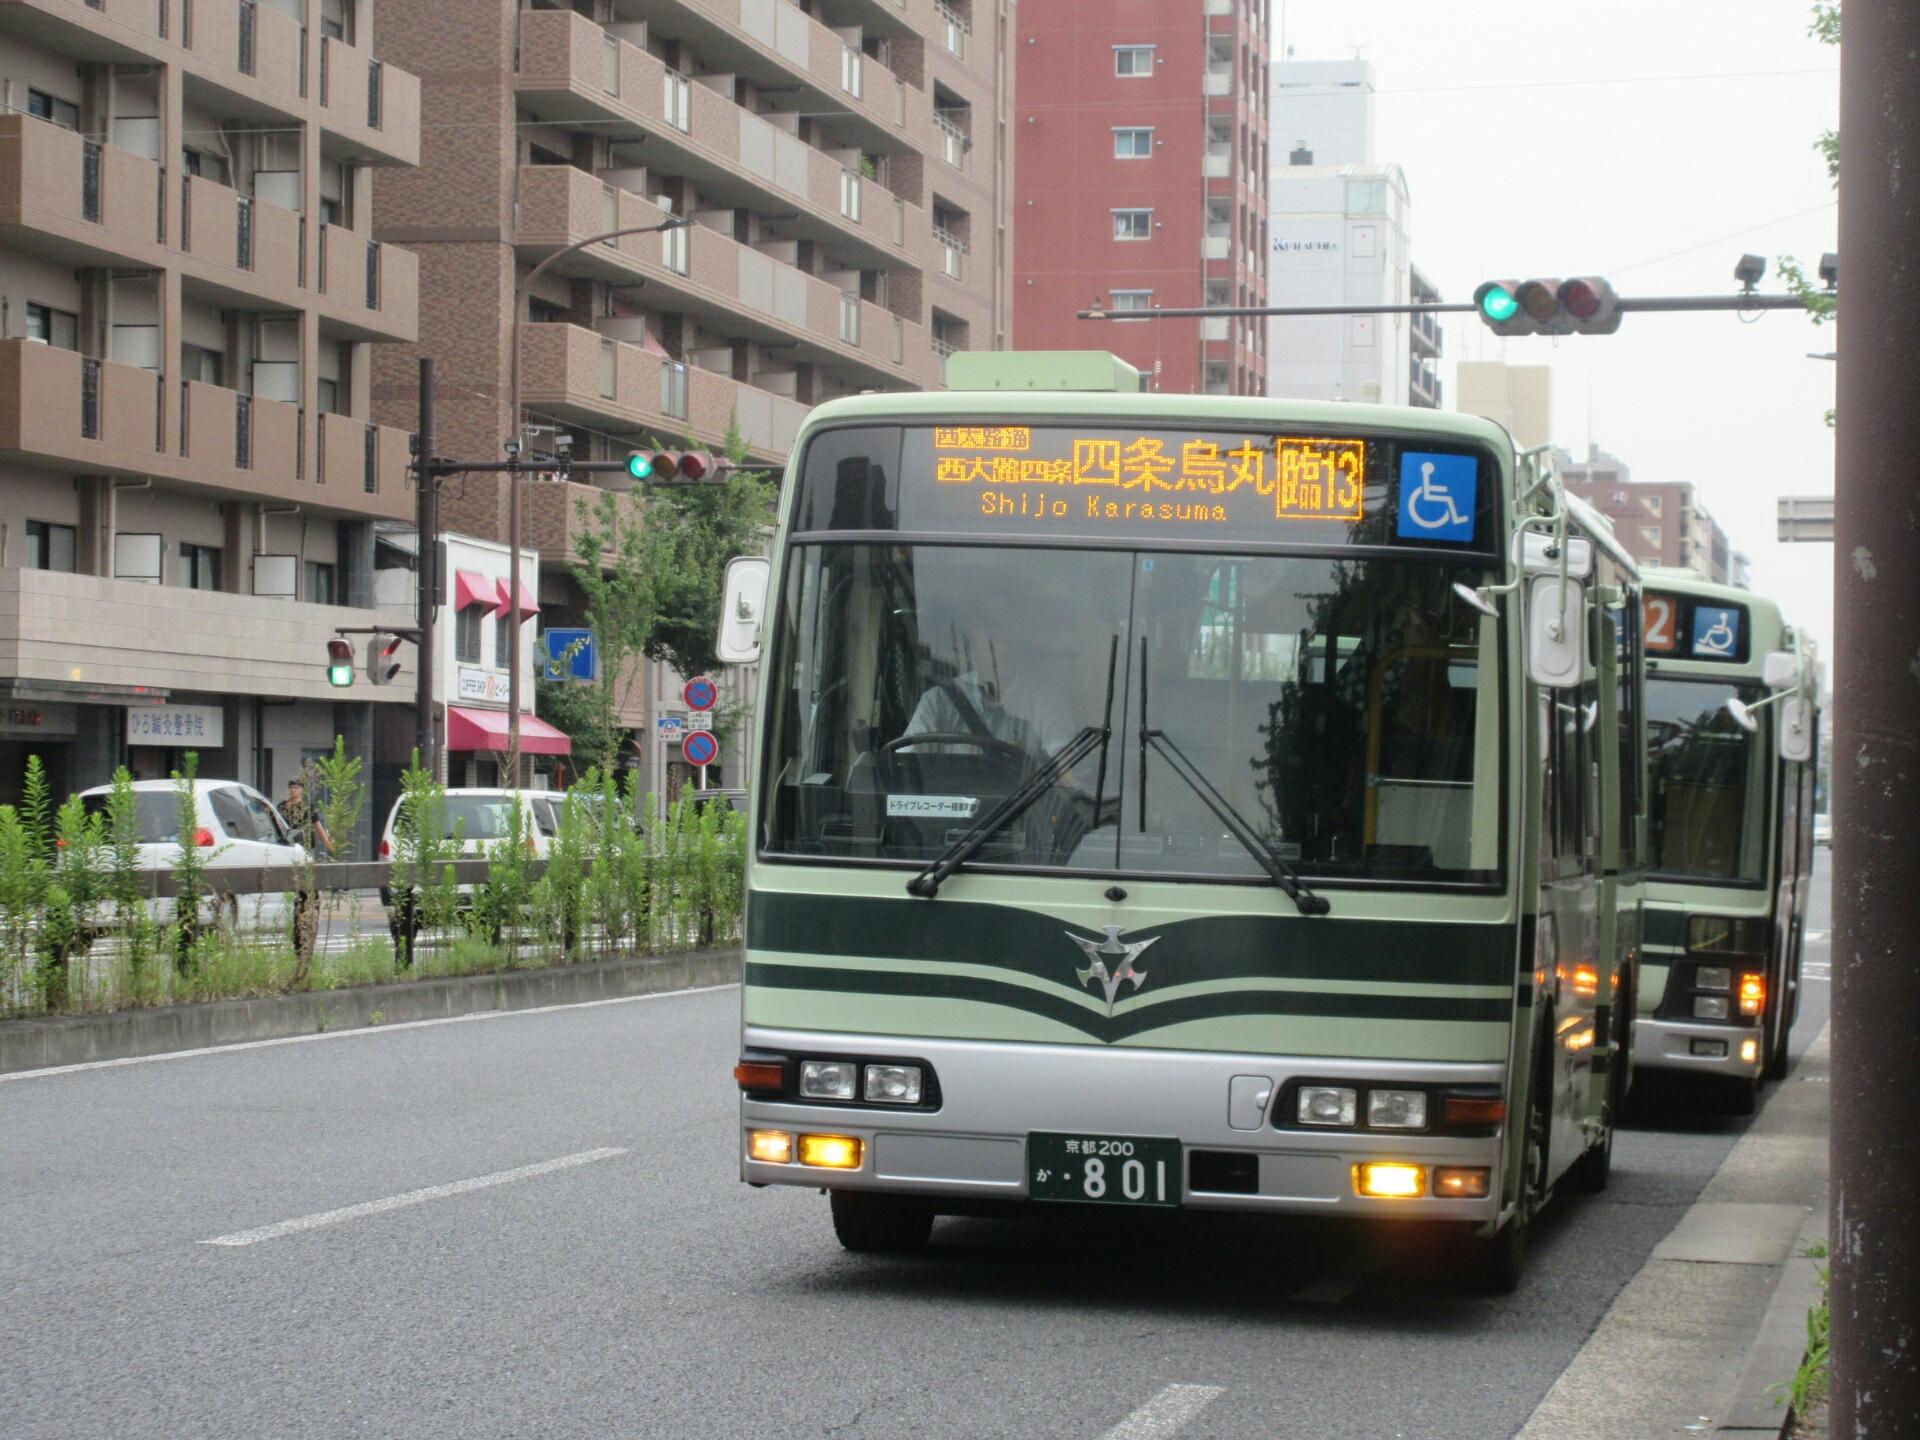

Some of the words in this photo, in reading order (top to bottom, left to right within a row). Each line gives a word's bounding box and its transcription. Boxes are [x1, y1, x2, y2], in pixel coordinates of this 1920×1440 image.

[937, 456, 1072, 484] 西大路四条
[1072, 437, 1275, 495] 四条烏丸
[982, 491, 1067, 517] Shijo
[1087, 495, 1226, 520] Karasuma
[1065, 1140, 1096, 1154] 京都
[1098, 1141, 1134, 1156] 200
[1036, 1168, 1052, 1182] か
